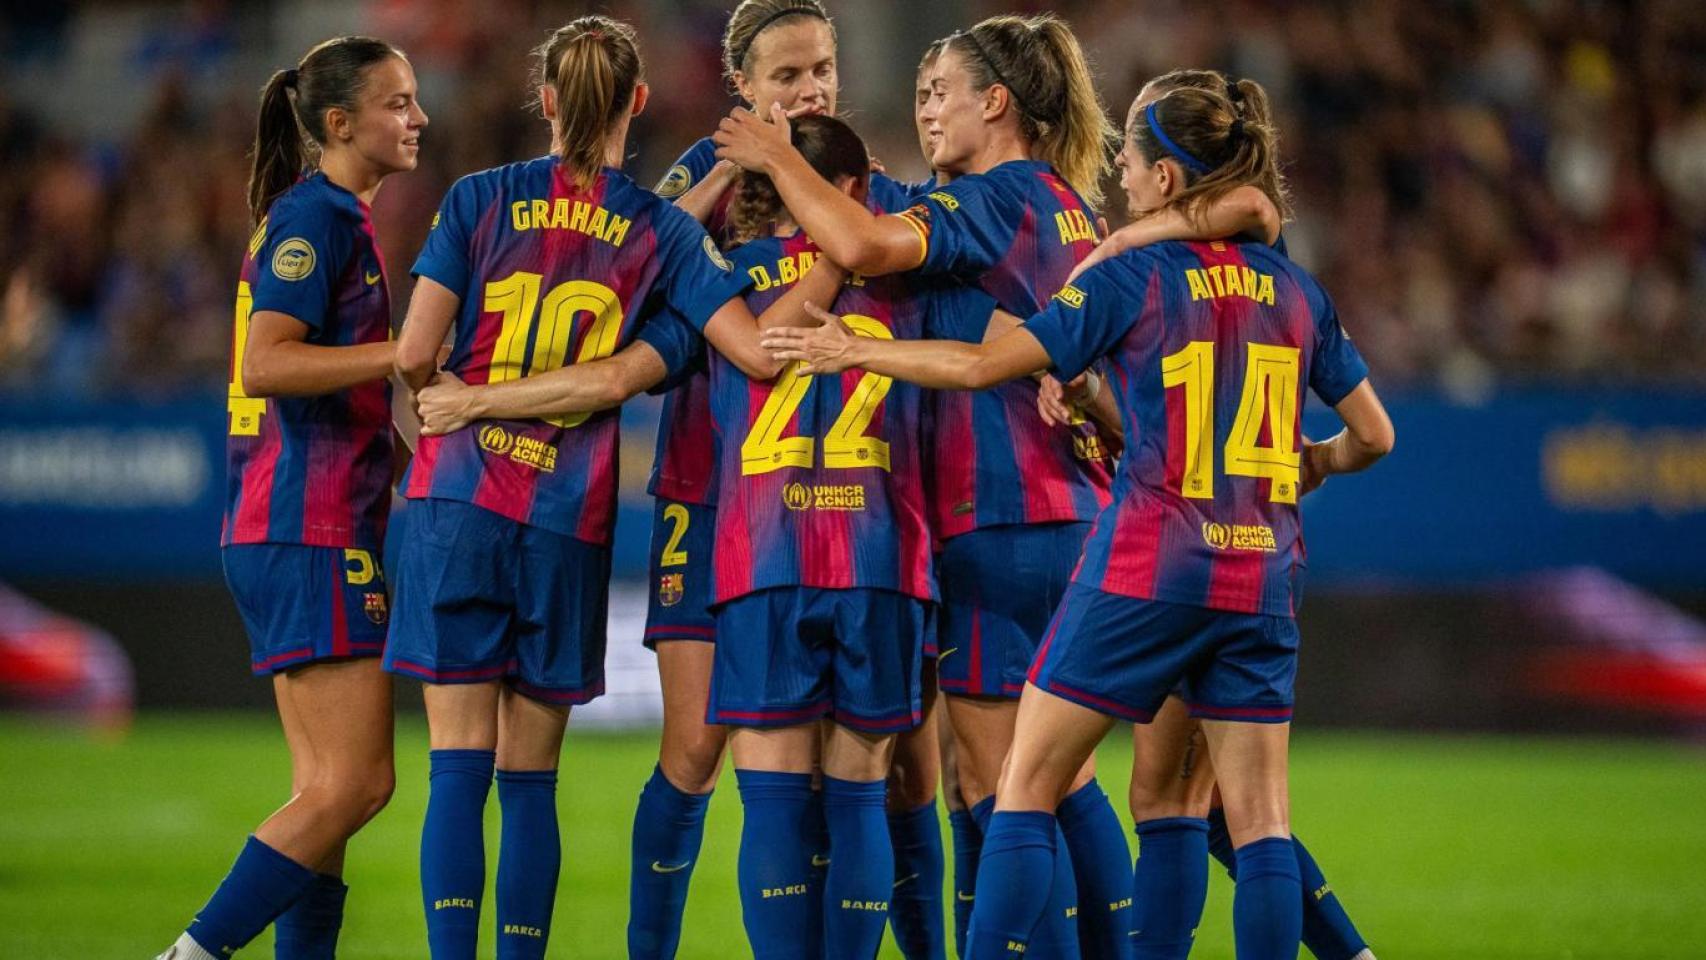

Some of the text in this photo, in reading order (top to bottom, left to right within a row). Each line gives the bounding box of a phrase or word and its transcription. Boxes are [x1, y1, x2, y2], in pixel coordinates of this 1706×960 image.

[512, 198, 631, 247] GRAHAM
[1186, 264, 1275, 306] AITANA
[484, 271, 624, 428] 10
[741, 314, 893, 476] 22
[1162, 341, 1300, 504] 14
[814, 486, 864, 496] UNHCR
[815, 497, 865, 506] ACNUR
[661, 503, 690, 567] 2
[1232, 525, 1274, 538] UNHCR
[1232, 536, 1276, 548] ACNUR
